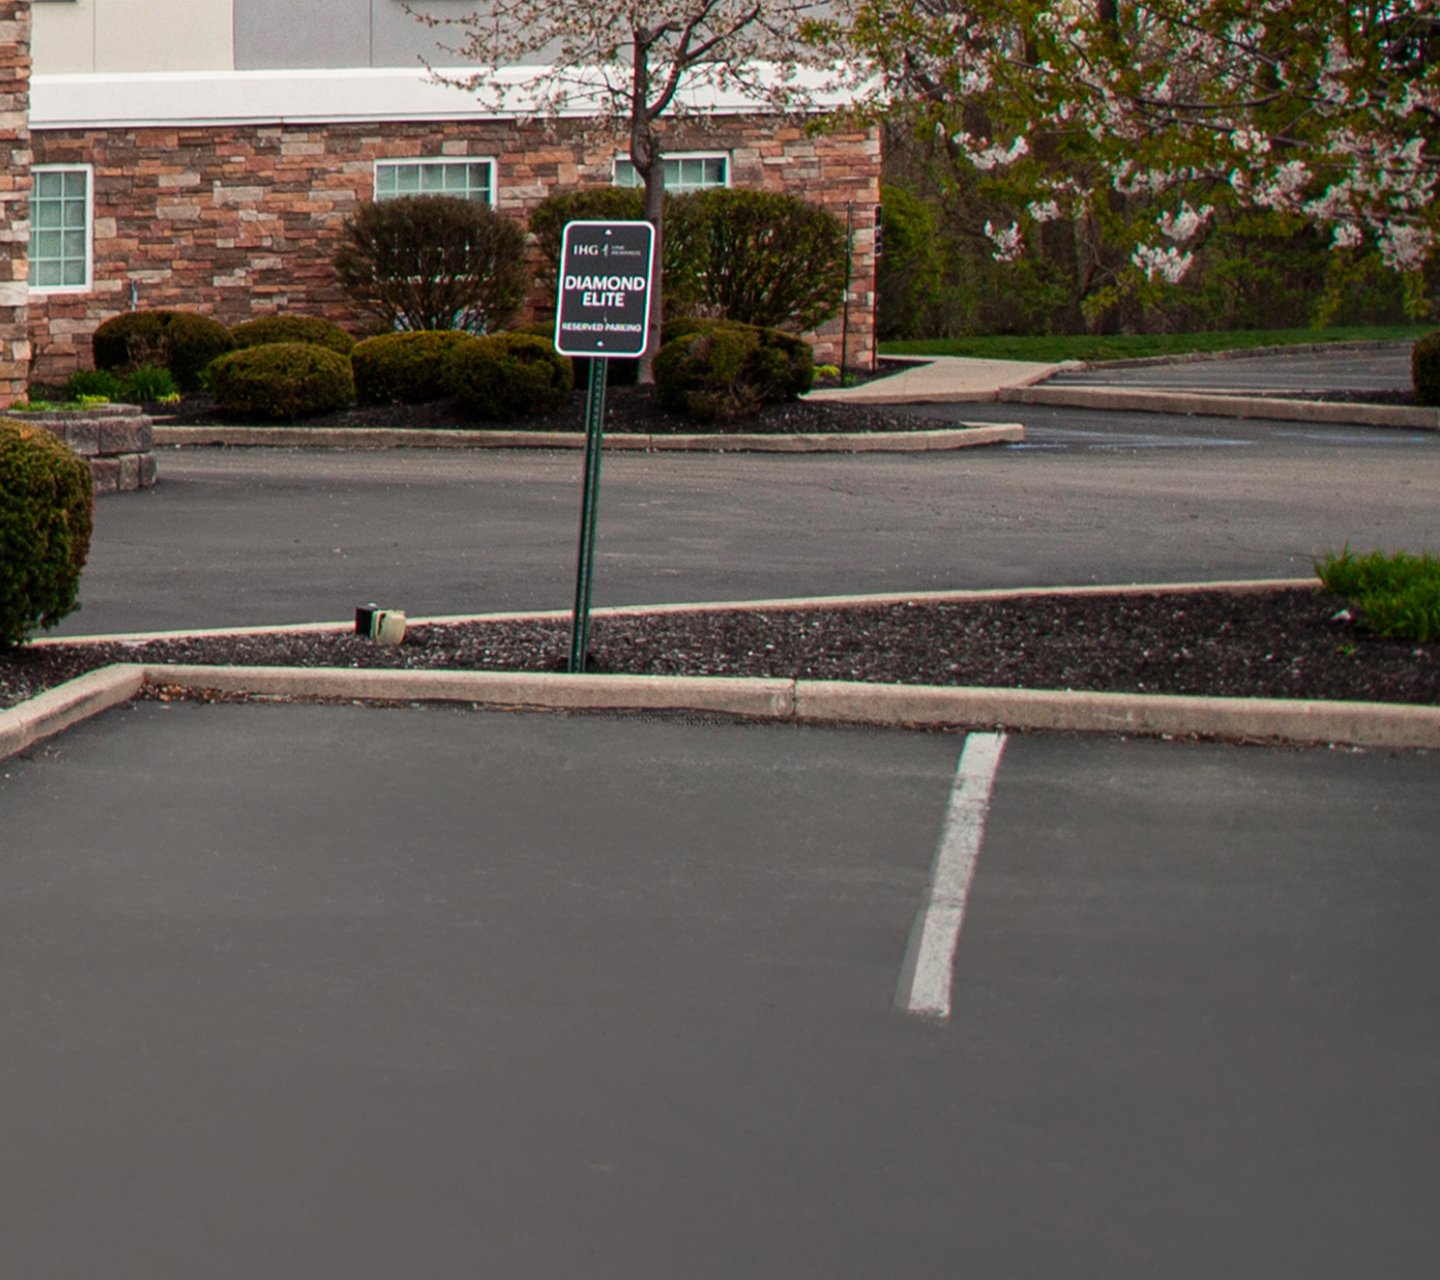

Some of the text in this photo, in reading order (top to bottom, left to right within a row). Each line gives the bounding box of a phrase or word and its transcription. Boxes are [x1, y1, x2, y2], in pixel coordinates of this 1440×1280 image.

[573, 244, 599, 256] IHG
[565, 275, 646, 291] DIAMOND
[582, 291, 626, 307] ELITE
[561, 322, 642, 333] RESERVED PARKING
